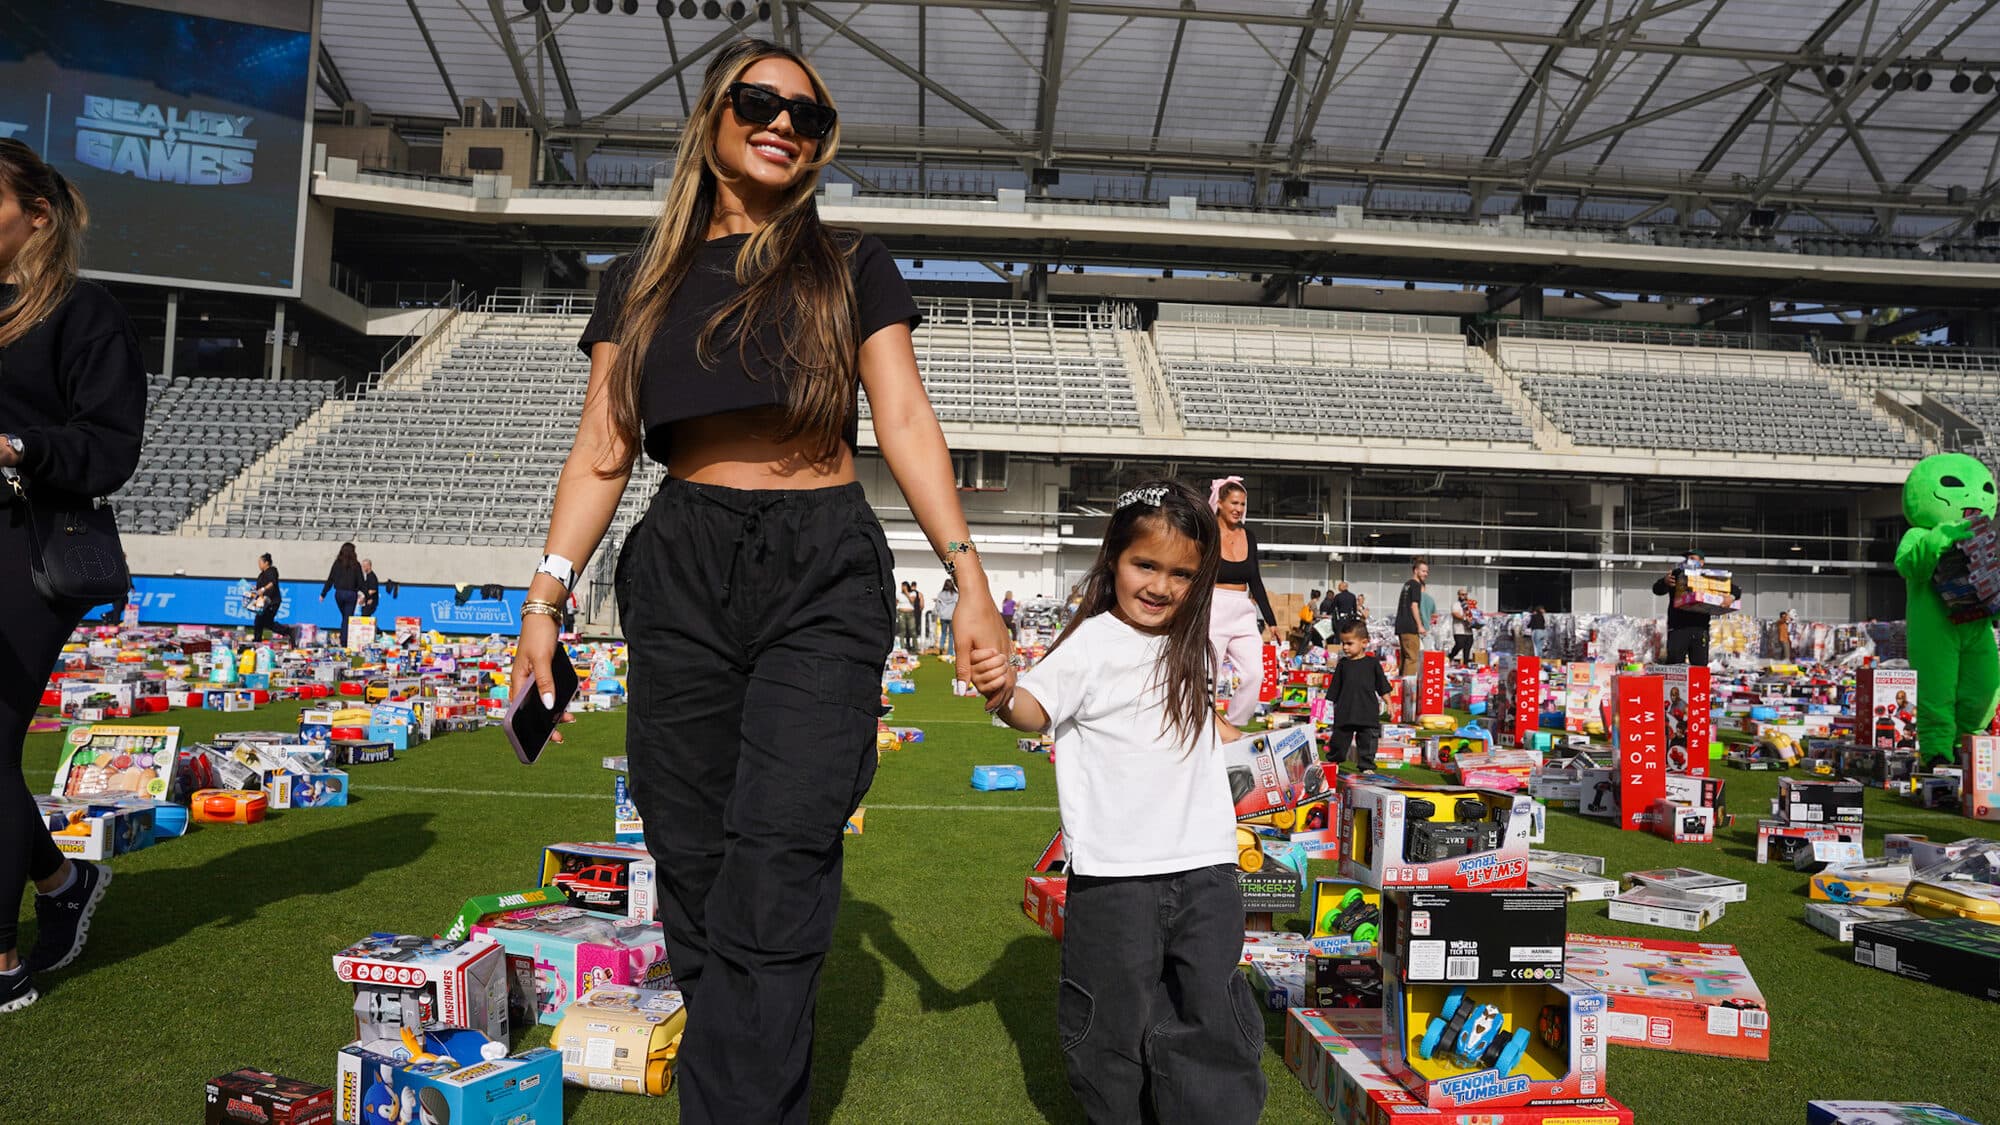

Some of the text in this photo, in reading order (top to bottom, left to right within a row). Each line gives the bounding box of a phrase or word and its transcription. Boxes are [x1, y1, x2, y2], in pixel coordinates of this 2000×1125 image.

[83, 95, 254, 137] REALITY
[75, 129, 254, 185] GAMES
[454, 611, 508, 621] TOY DRIVE
[1426, 660, 1434, 705] TYSON
[1528, 677, 1536, 712] MIKE
[1692, 681, 1700, 748] TYSON
[1699, 692, 1707, 737] MIKE
[1628, 696, 1643, 786] TYSON
[1644, 711, 1657, 769] MIKE
[359, 750, 390, 763] GALAXY
[1460, 854, 1498, 872] TRUCK
[1467, 857, 1526, 887] S.W.A.T.
[498, 890, 548, 908] SUBWAY
[1240, 884, 1296, 893] TRIKER-X
[1314, 939, 1348, 948] VENOM
[1450, 941, 1478, 949] WORLD
[443, 969, 454, 1026] RANSFORMERS
[207, 1093, 218, 1103] 6+
[342, 1070, 353, 1122] SONIC
[1441, 1074, 1495, 1097] VENOM
[1456, 1079, 1529, 1104] TUMBLER
[1551, 1086, 1563, 1095] 6+
